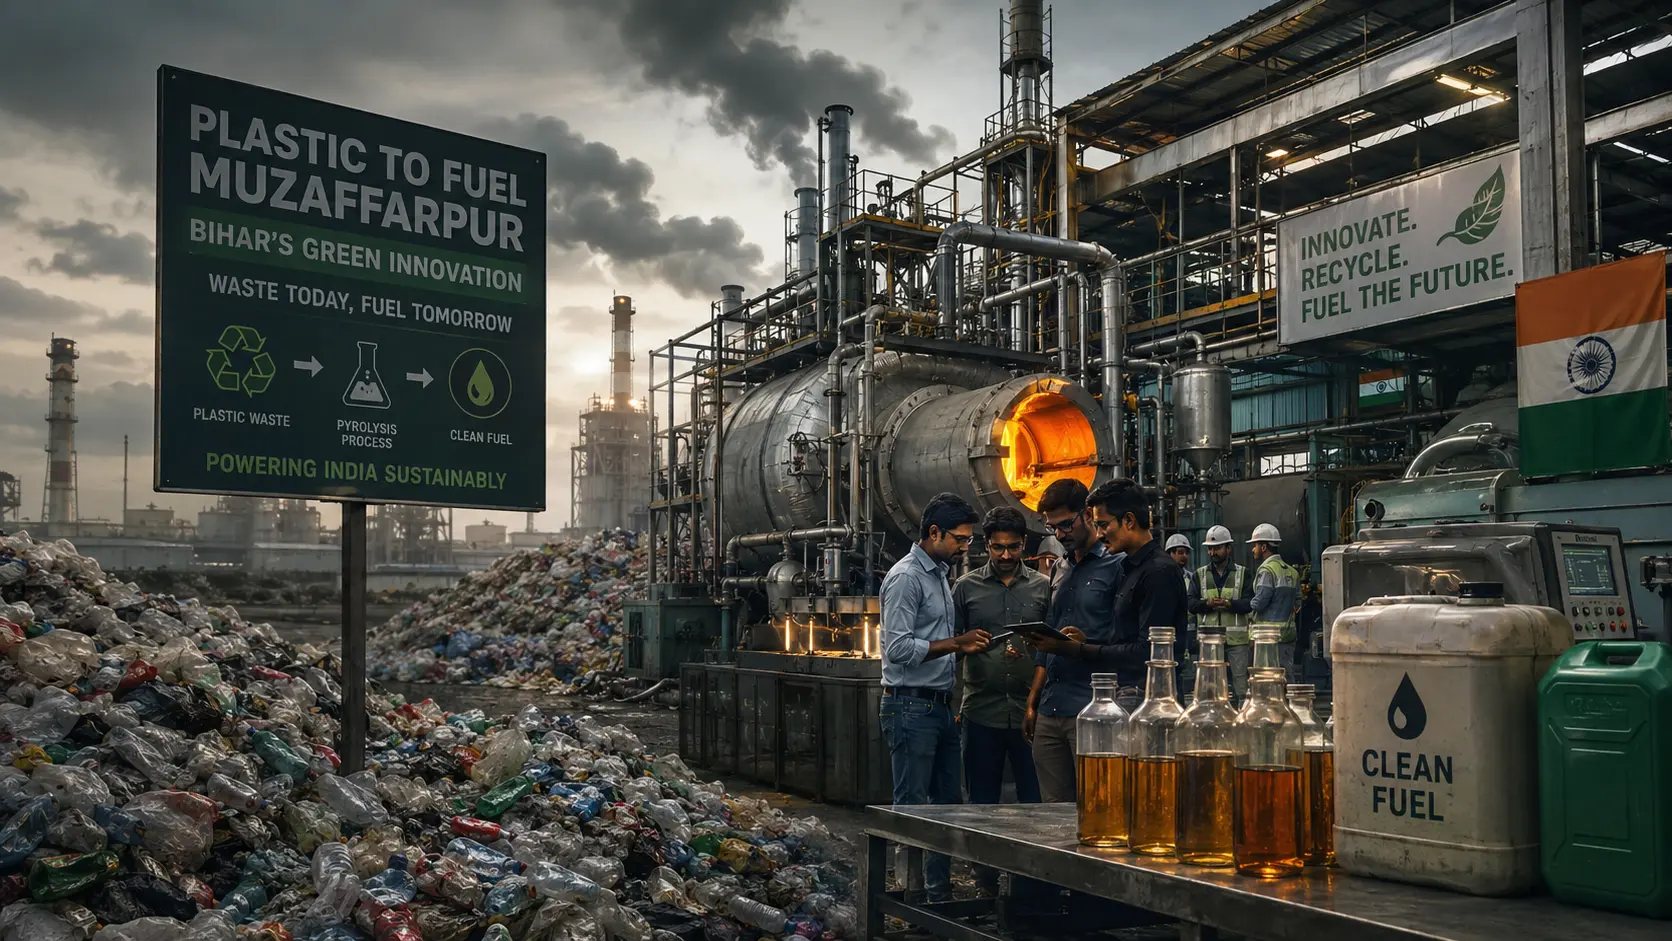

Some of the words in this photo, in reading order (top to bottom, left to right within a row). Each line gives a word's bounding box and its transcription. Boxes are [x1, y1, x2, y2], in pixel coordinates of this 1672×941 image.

[190, 103, 367, 174] PLASTIC
[379, 144, 430, 187] TO
[443, 158, 527, 207] FUEL
[190, 151, 524, 252] MUZAFFARPUR
[1301, 207, 1417, 260] INNOVATE.
[190, 218, 294, 256] BIHAR'S
[302, 237, 381, 270] GREEN
[390, 251, 523, 292] INNOVATION
[1301, 243, 1409, 291] RECYCLE.
[209, 274, 279, 301] WASTE
[285, 284, 354, 314] TODAY,
[361, 295, 406, 318] FUEL
[411, 303, 512, 333] TOMORROW
[1301, 290, 1352, 323] FUEL
[1359, 278, 1401, 309] THE
[1410, 252, 1514, 298] FUTURE.
[193, 407, 246, 424] PLASTIC
[249, 412, 290, 427] WASTE
[337, 419, 397, 435] PYROLYSIS
[450, 429, 484, 443] CLEAN
[487, 432, 512, 445] FUEL
[341, 434, 393, 449] PROCESS
[206, 452, 317, 479] POWERING
[324, 460, 378, 481] INDIA
[385, 464, 507, 489] SUSTAINABLY
[1362, 748, 1453, 784] CLEAN
[1372, 785, 1445, 822] FUEL
